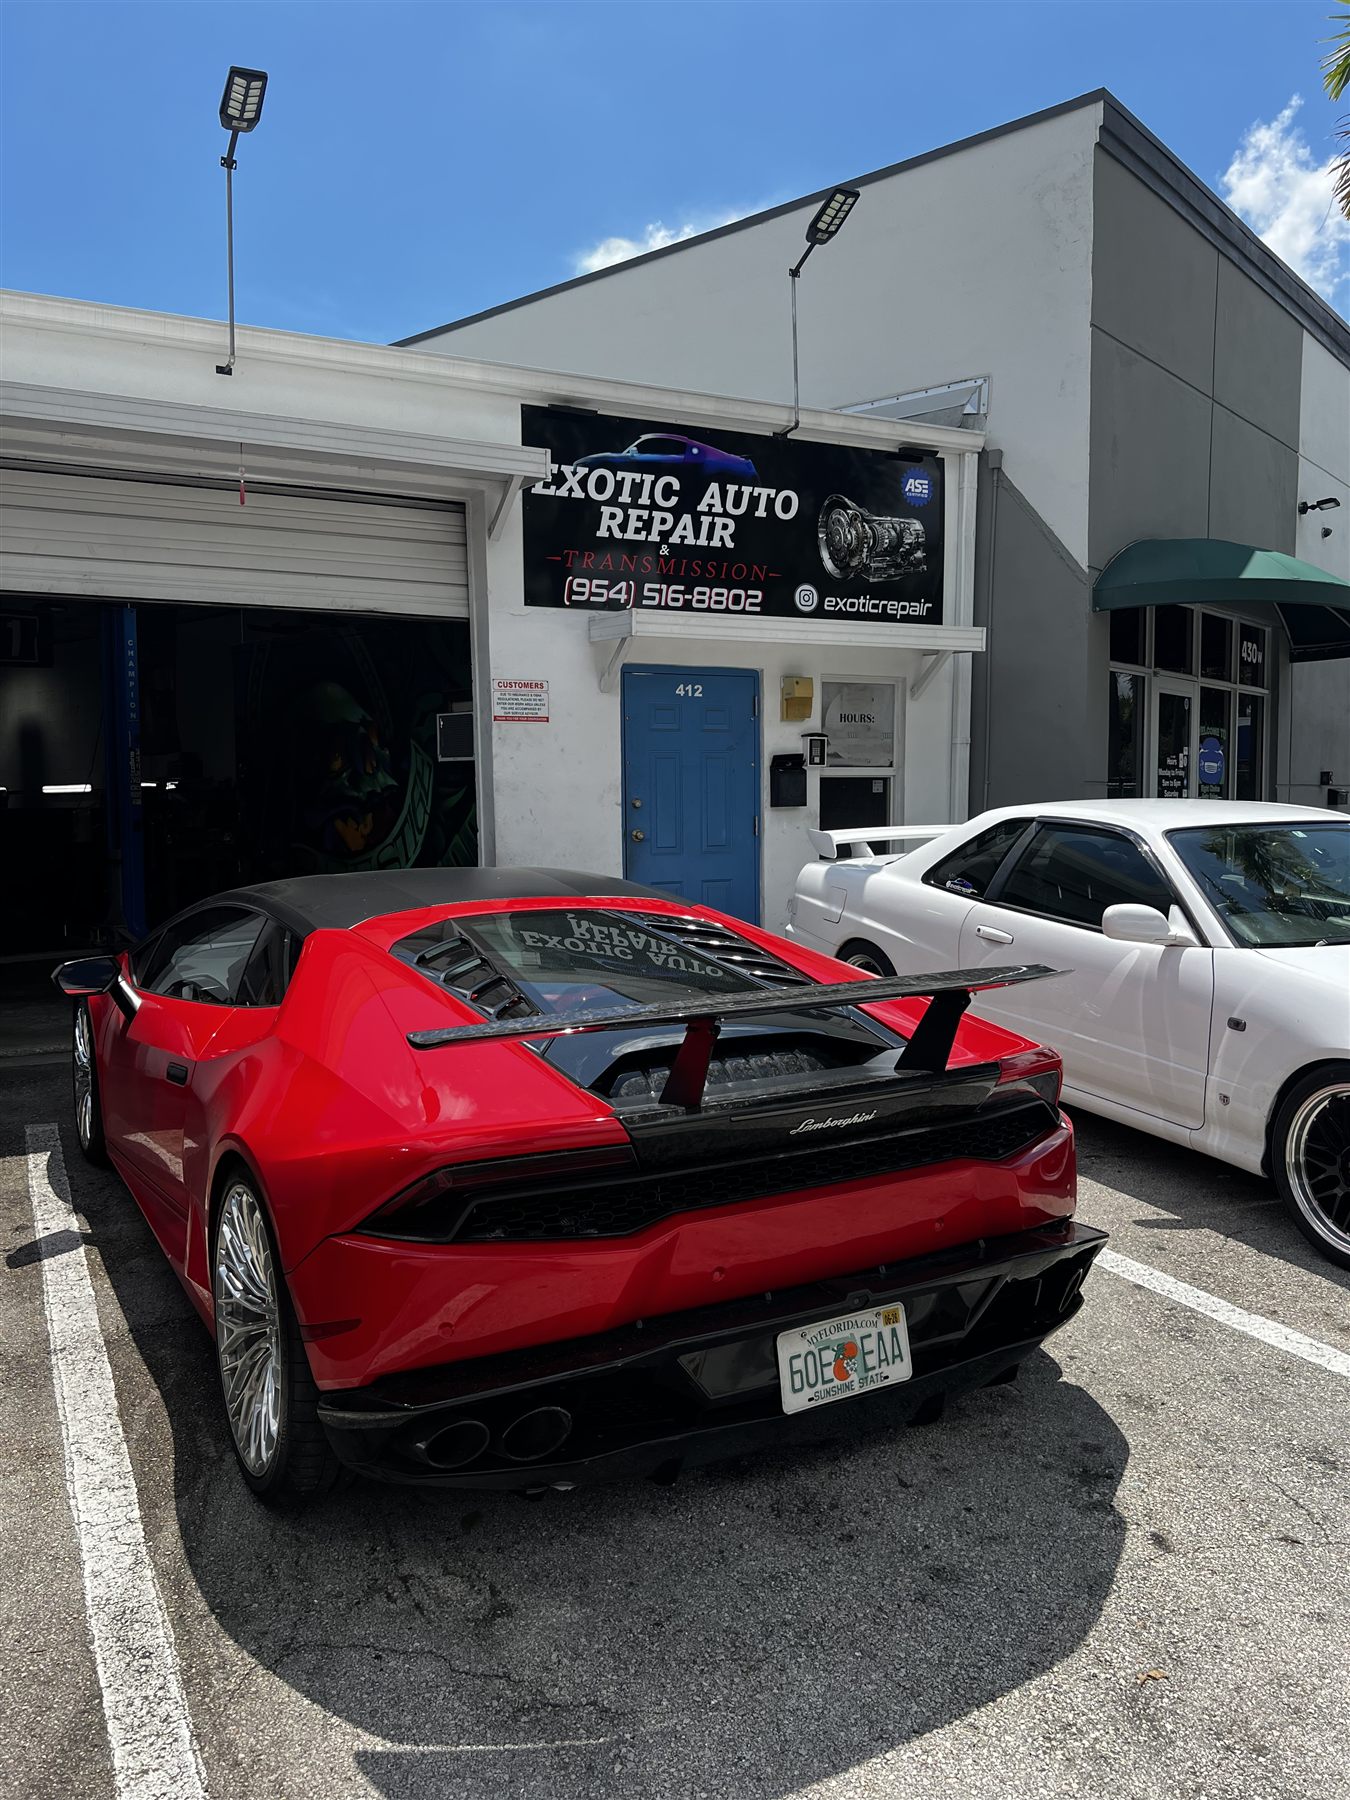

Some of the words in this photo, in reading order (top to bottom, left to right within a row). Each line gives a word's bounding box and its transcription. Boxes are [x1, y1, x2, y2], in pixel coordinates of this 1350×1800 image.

[531, 463, 681, 508] EXOTIC
[697, 482, 799, 520] AUTO
[905, 478, 928, 493] ASE
[596, 505, 735, 549] REPAIR
[659, 544, 670, 555] &
[563, 550, 768, 581] TRANSMISSION
[564, 576, 635, 609] (954)
[642, 583, 763, 611] 516-8802
[824, 595, 932, 619] exoticrepair
[127, 639, 137, 719] CHAMPION
[497, 681, 544, 689] CUSTOMERS
[675, 683, 703, 697] 412
[840, 713, 875, 723] HOURS:
[789, 1110, 877, 1134] Lamborghini
[806, 1319, 878, 1347] MYFLORIDA.COM
[813, 1380, 856, 1401] SUNSHINE
[858, 1372, 884, 1389] STATE
